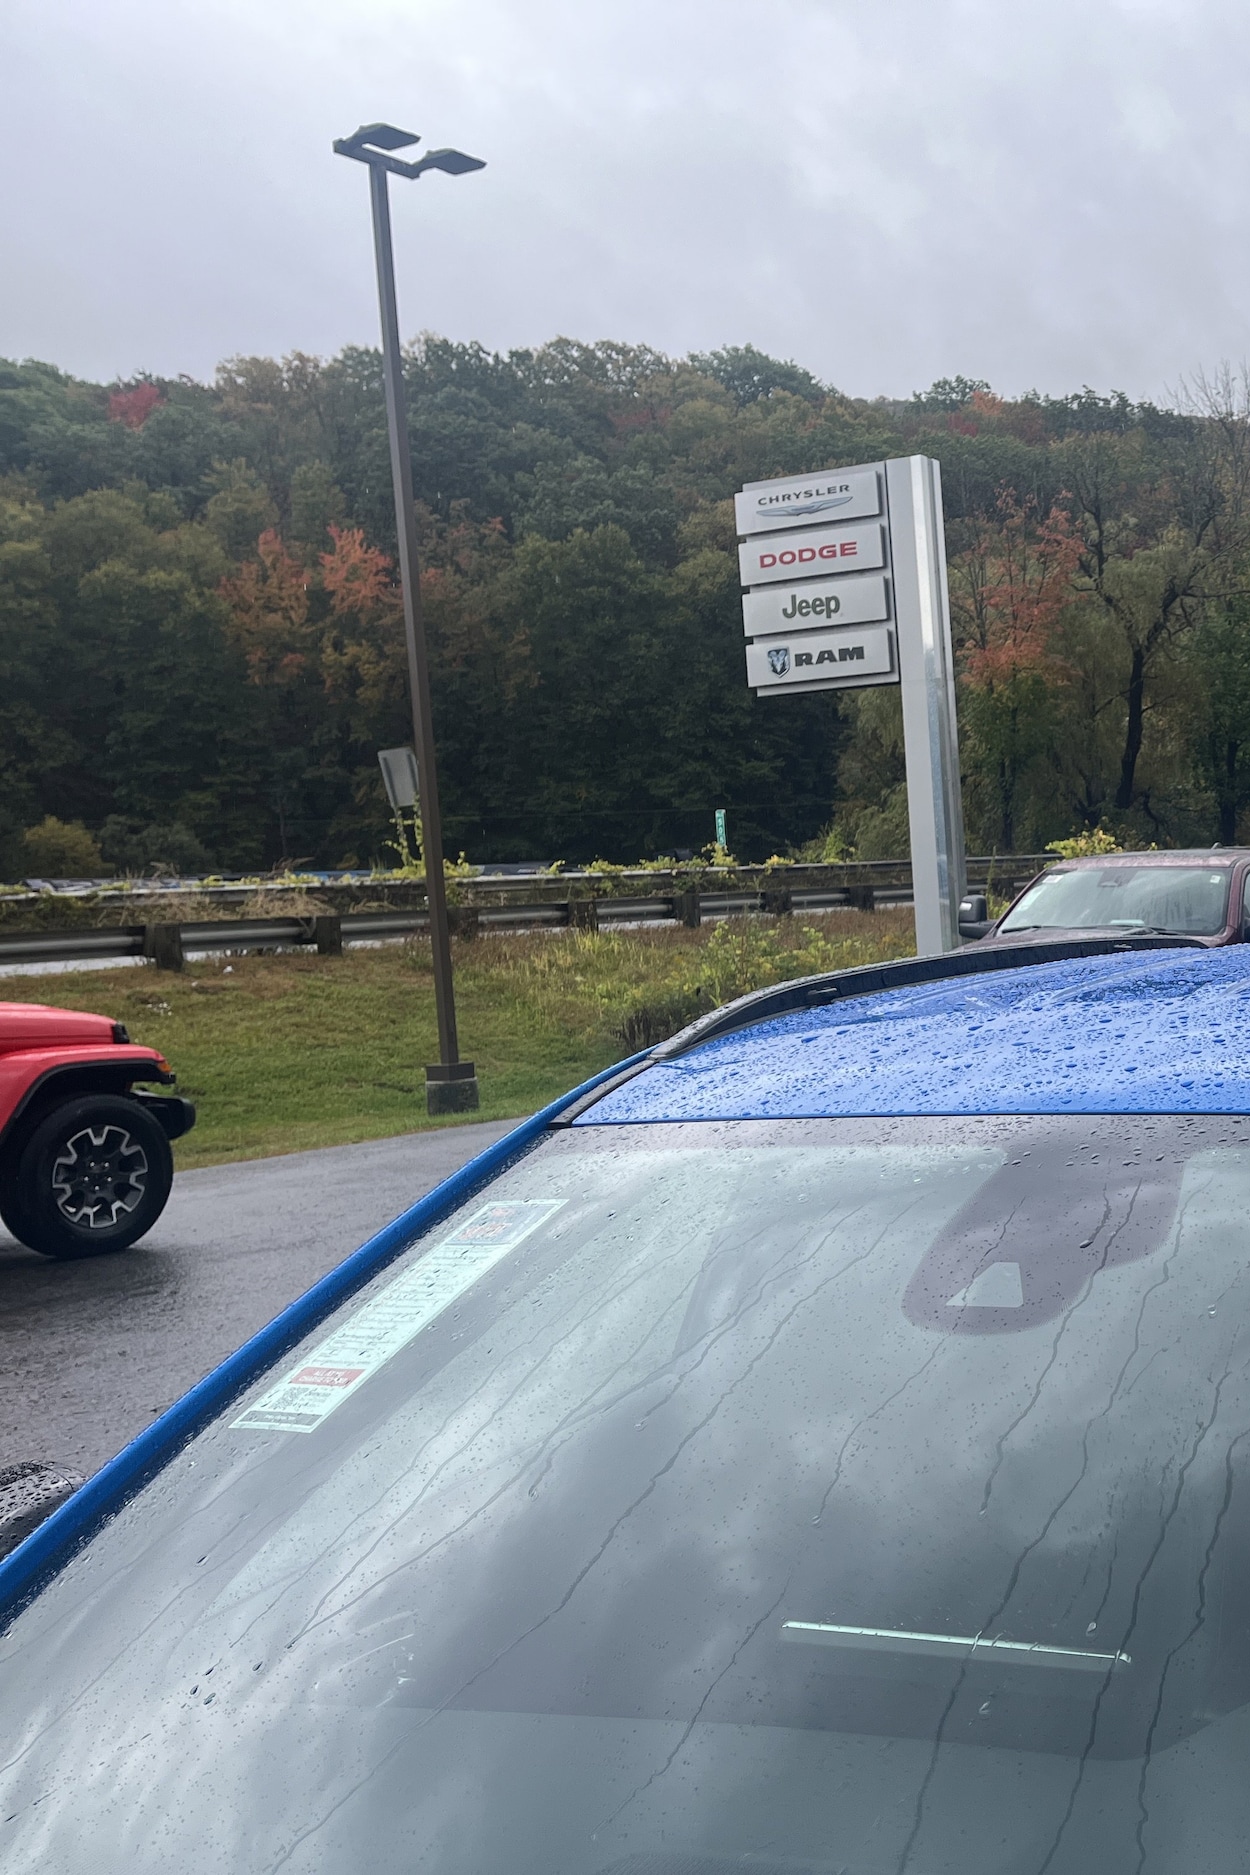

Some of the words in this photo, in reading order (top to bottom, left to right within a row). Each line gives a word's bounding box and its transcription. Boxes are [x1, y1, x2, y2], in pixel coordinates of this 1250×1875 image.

[758, 484, 851, 506] CHRYSLER
[759, 541, 858, 568] DODGE
[782, 594, 840, 619] Jeep
[794, 646, 865, 667] RAM
